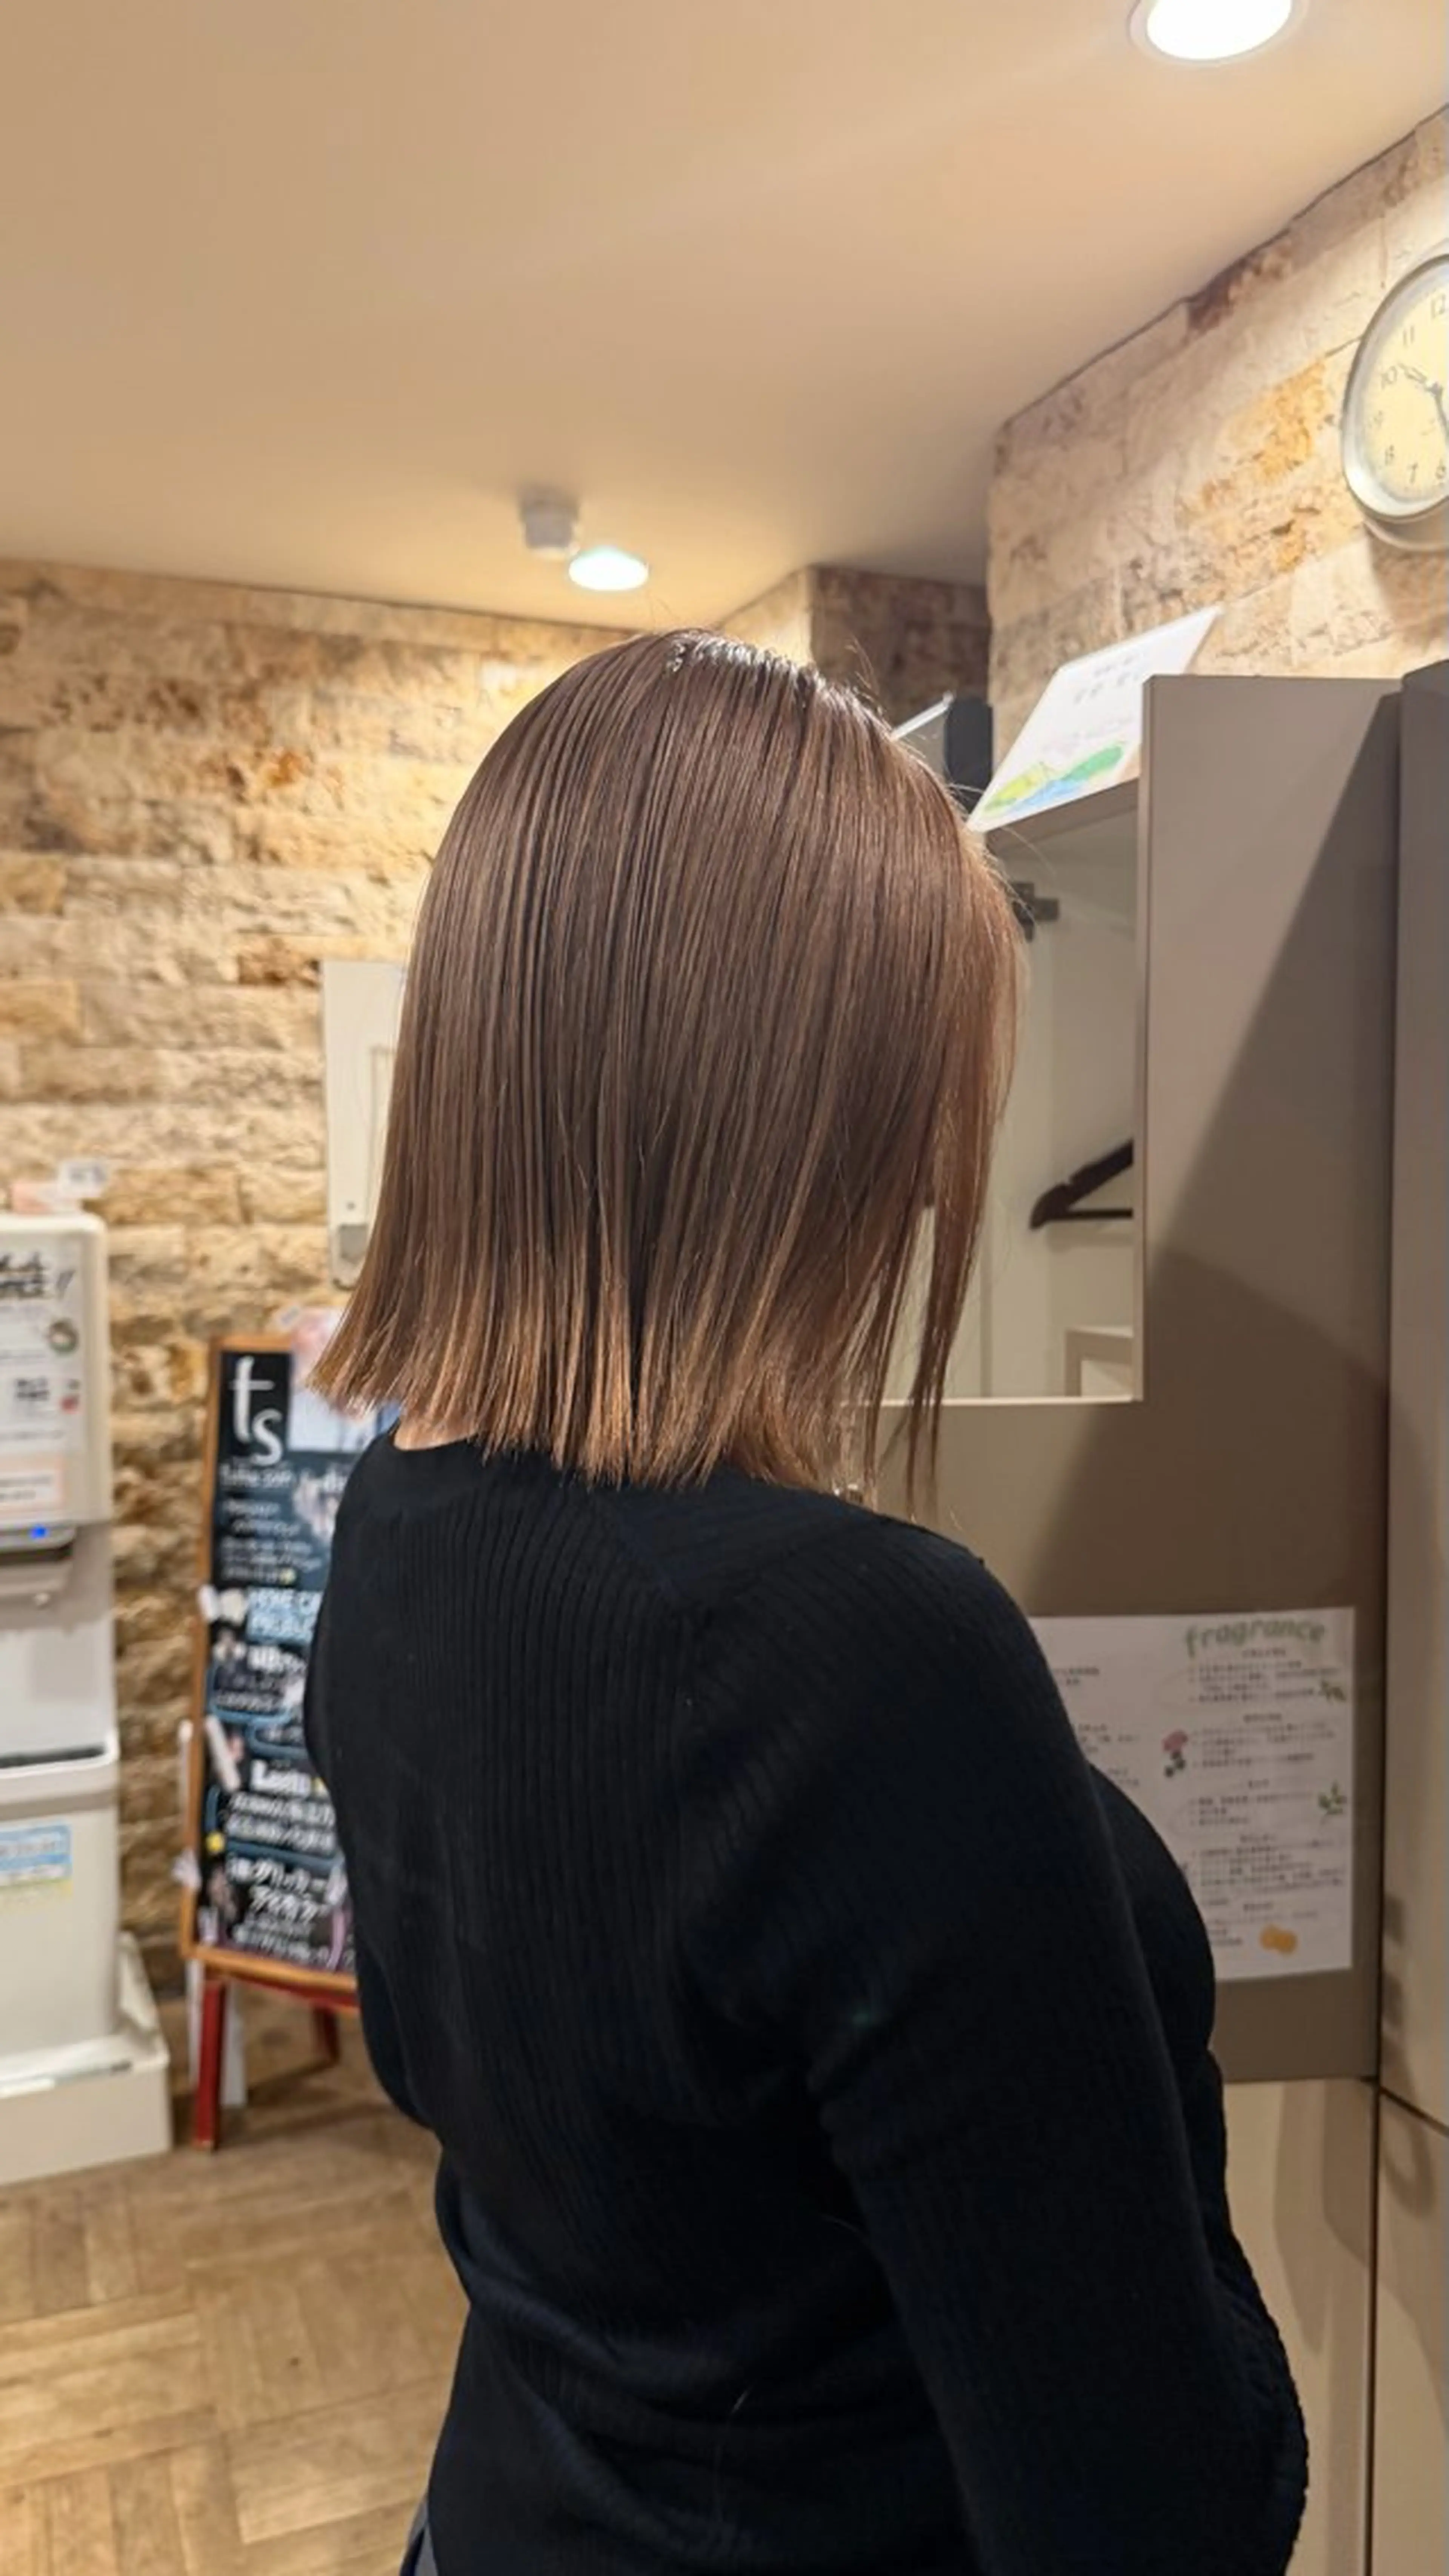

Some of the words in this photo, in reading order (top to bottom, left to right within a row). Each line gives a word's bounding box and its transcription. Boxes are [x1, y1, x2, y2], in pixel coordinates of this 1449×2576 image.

[1402, 324, 1415, 347] 11
[1380, 365, 1398, 390] 10
[1406, 461, 1419, 484] 7
[1184, 1618, 1326, 1659] fragrance
